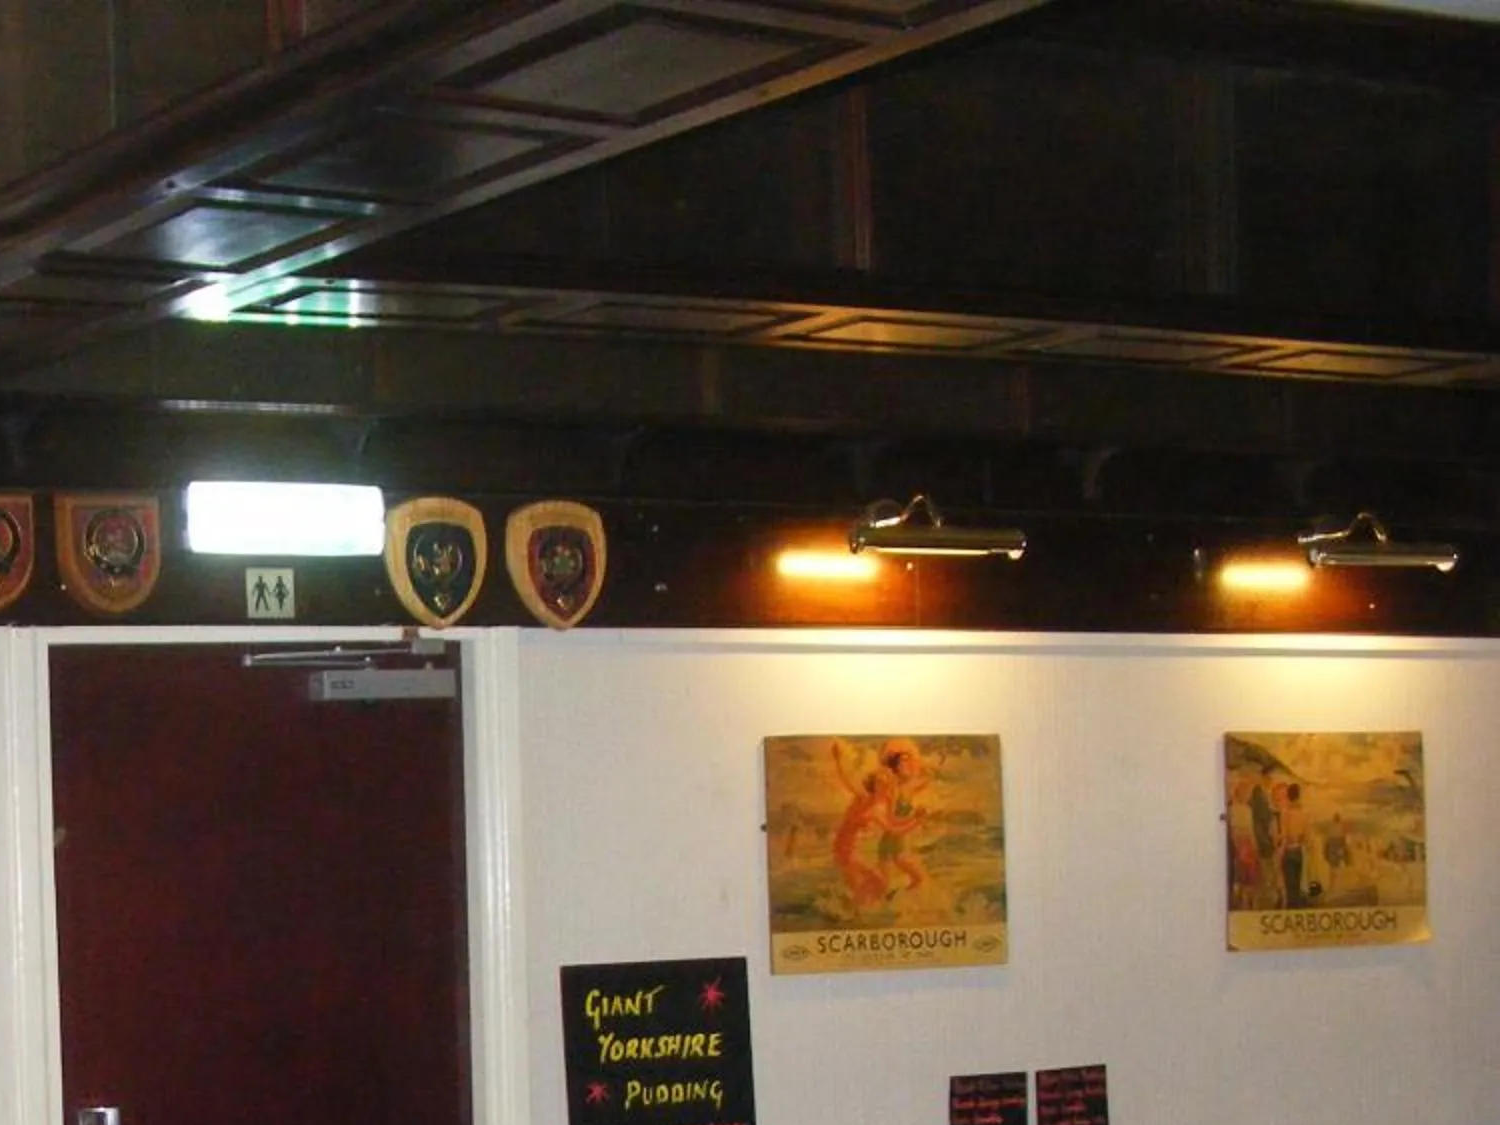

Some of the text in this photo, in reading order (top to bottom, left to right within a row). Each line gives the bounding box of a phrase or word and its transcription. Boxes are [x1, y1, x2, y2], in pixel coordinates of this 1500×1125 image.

[1260, 910, 1397, 935] SCARBOROUGH
[817, 930, 967, 954] SCARBOROUGH
[585, 984, 666, 1029] GIANT
[598, 1032, 723, 1064] YORKSHIRE
[624, 1080, 724, 1110] PUDDING
